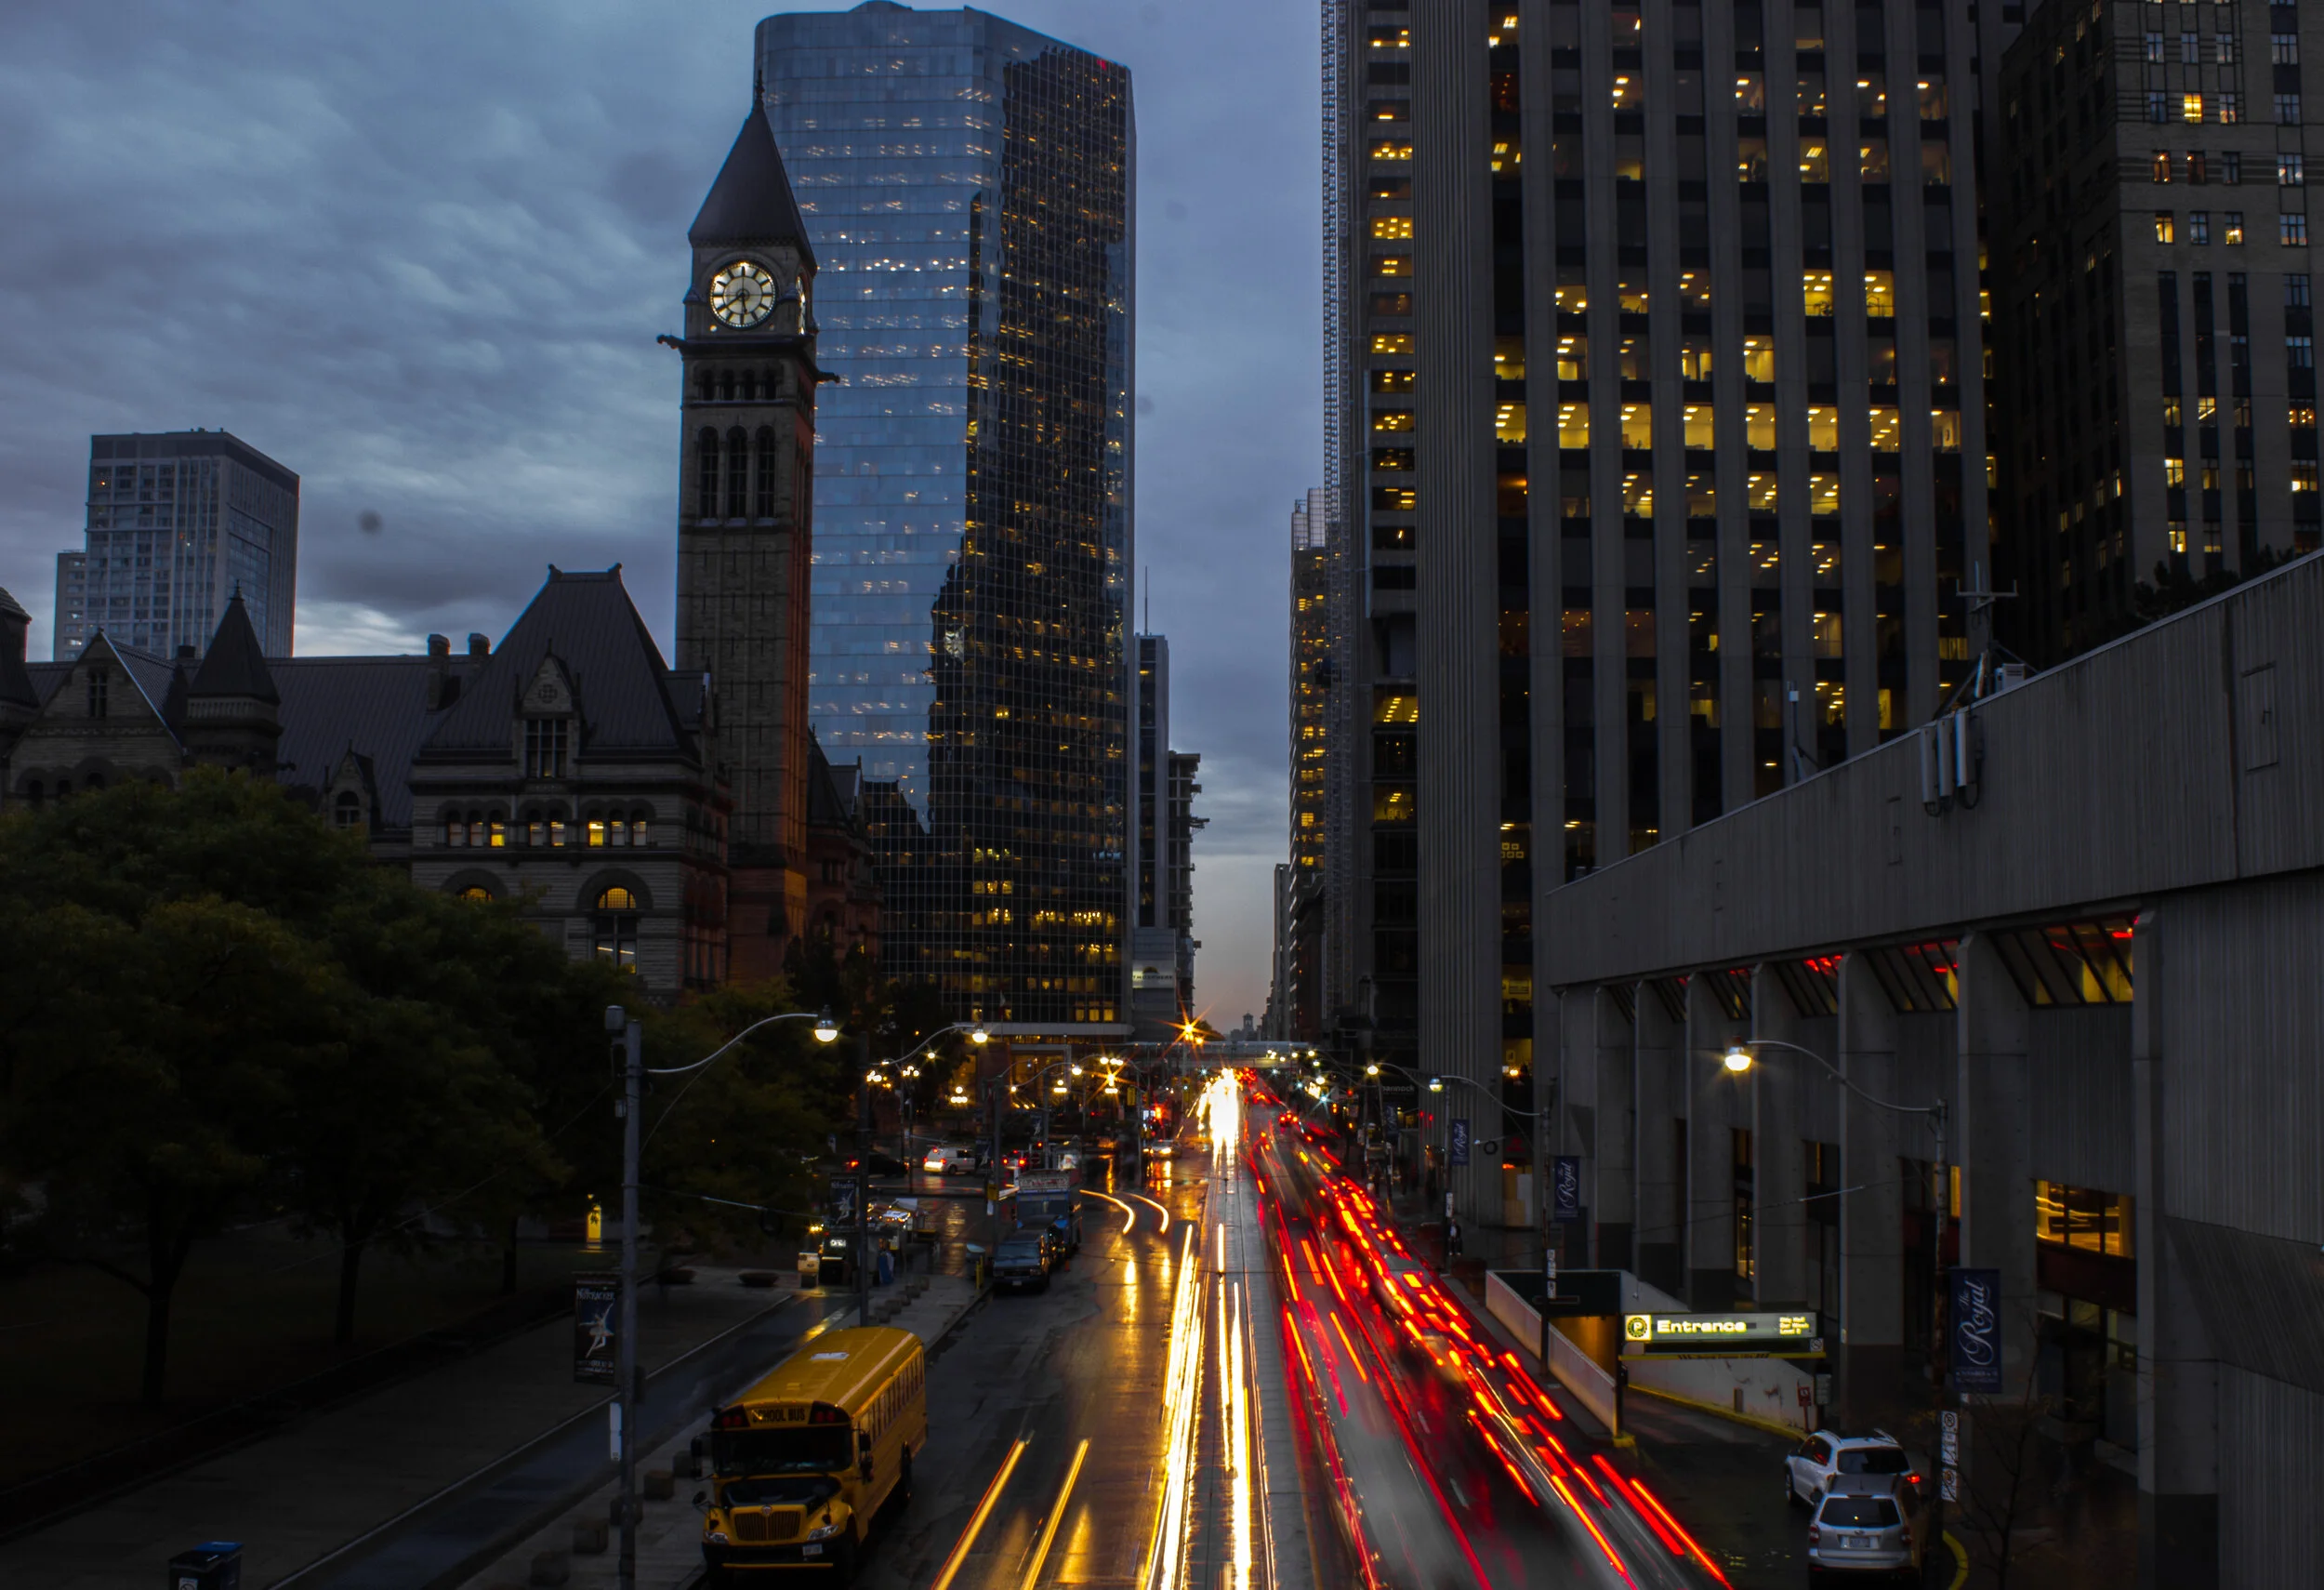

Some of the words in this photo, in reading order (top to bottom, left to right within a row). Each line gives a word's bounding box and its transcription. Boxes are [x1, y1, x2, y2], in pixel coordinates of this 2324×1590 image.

[1556, 1161, 1577, 1208] Royal
[1657, 1319, 1747, 1333] Entrance
[1957, 1276, 1994, 1365] Royal
[787, 1407, 806, 1422] BUS
